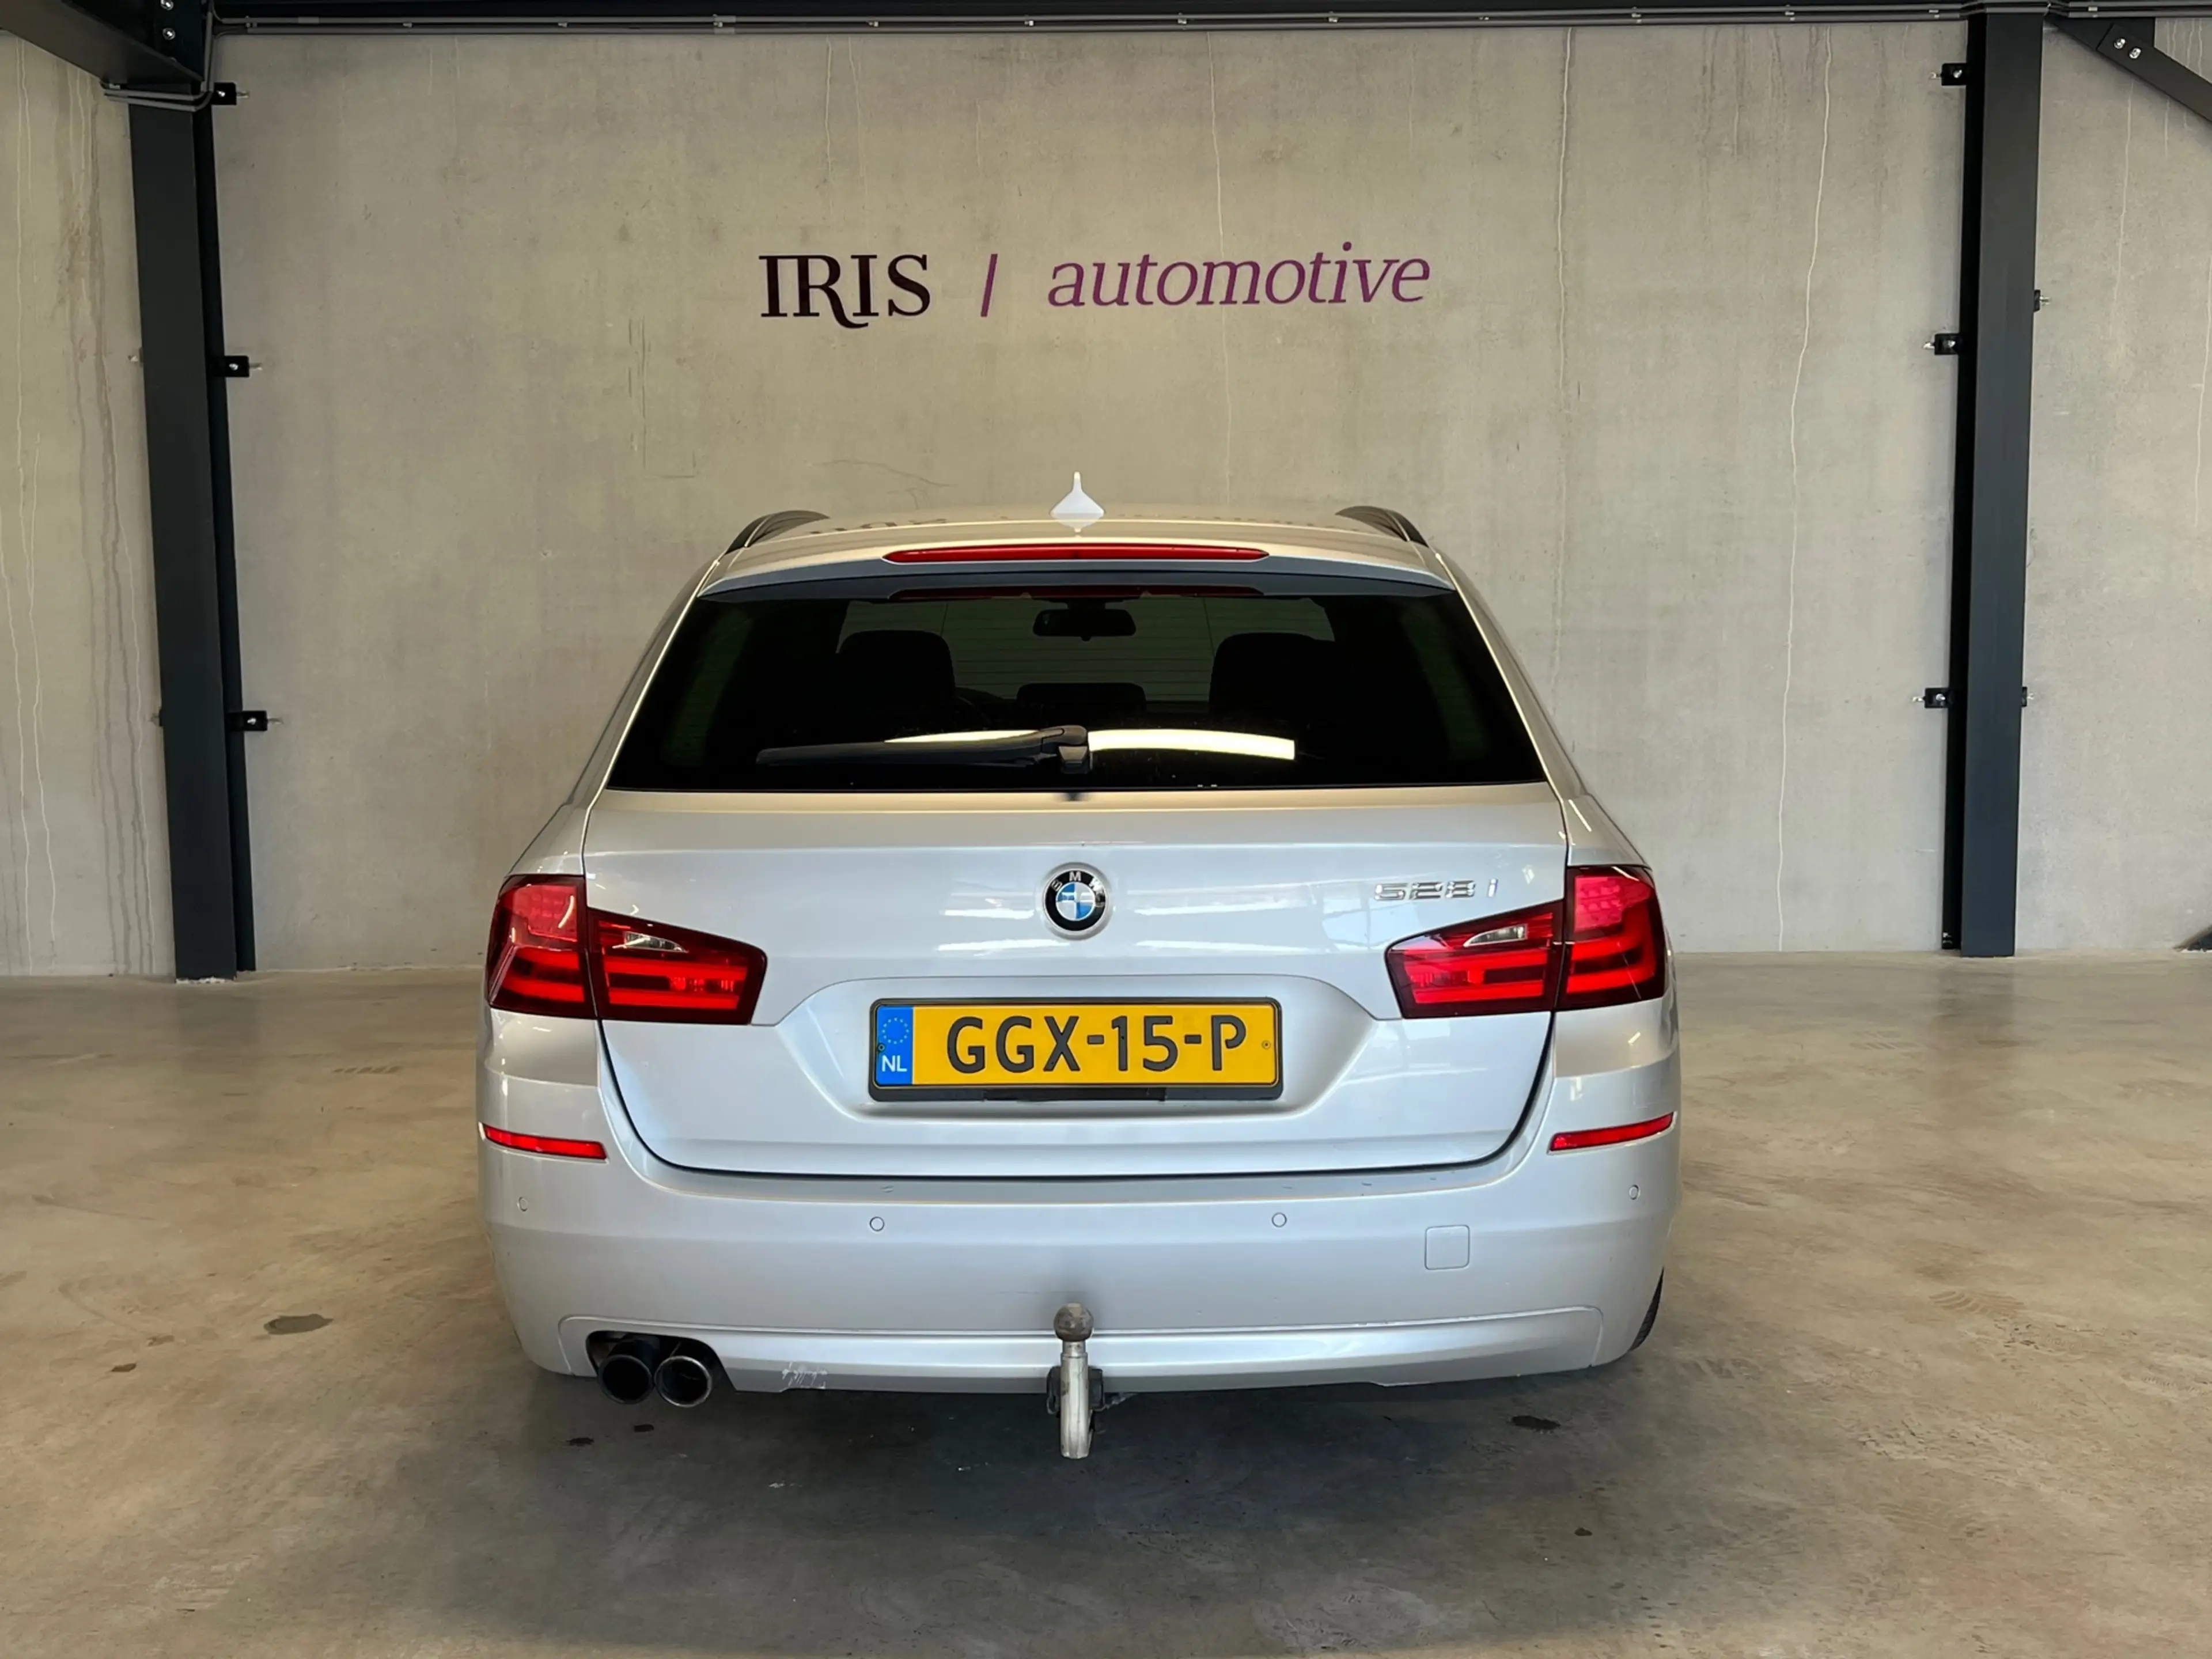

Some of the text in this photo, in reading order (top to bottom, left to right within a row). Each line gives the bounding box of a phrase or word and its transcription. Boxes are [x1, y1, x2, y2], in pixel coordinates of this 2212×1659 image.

[758, 253, 931, 328] IRIS
[1047, 241, 1431, 307] automotive
[1050, 870, 1104, 893] BMW
[881, 1015, 1247, 1074] NL GGX-15-P
